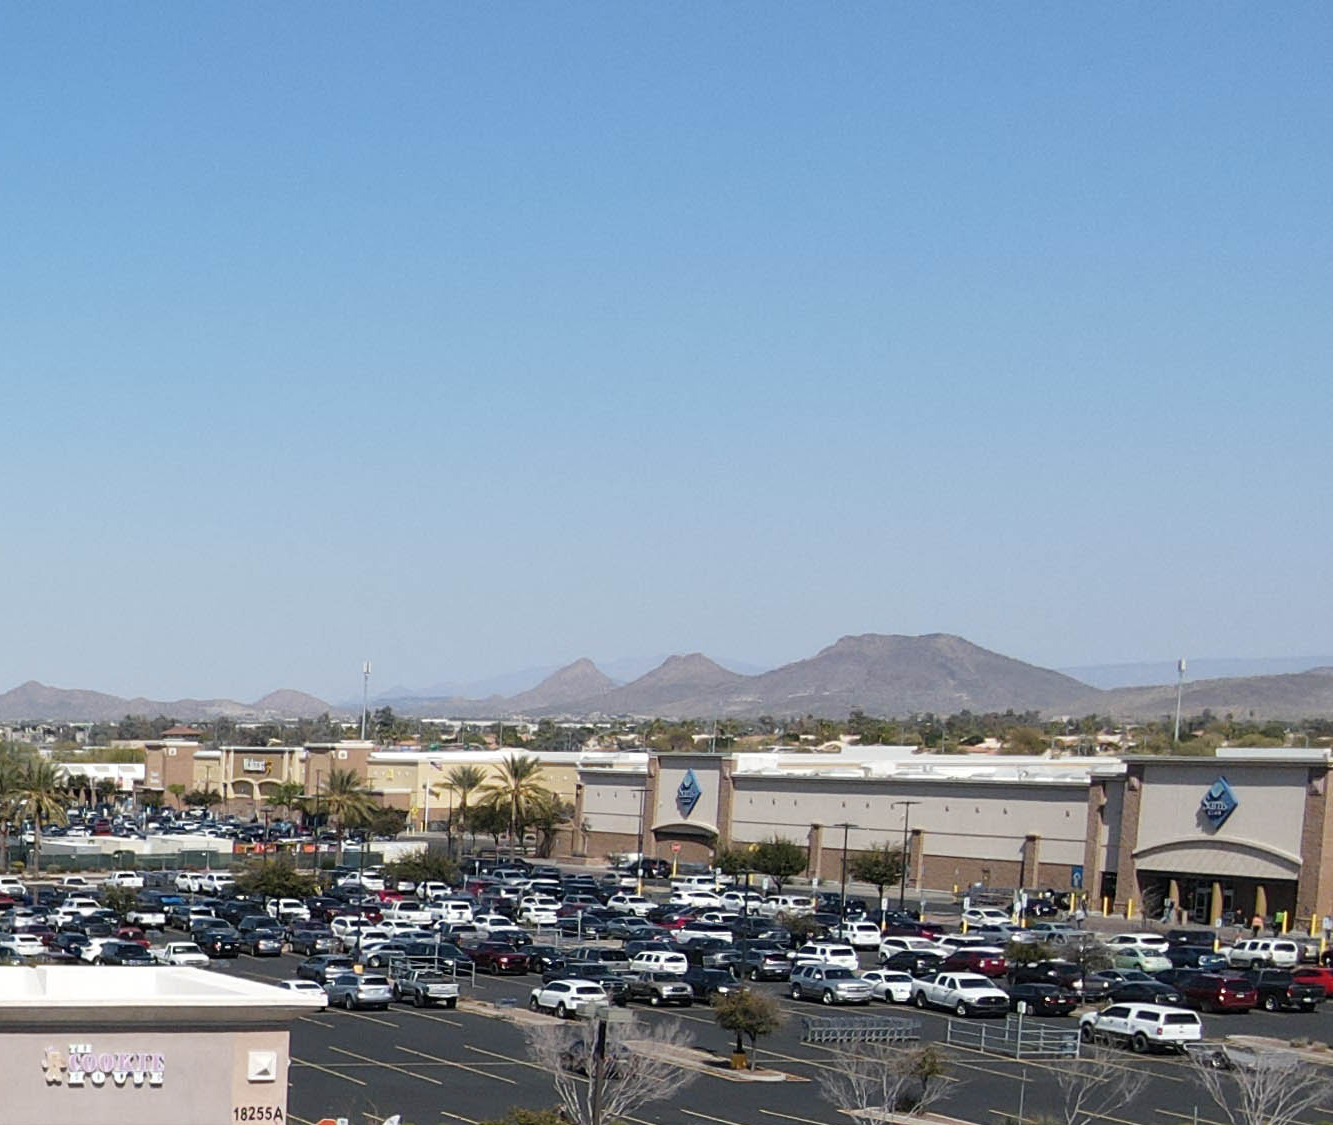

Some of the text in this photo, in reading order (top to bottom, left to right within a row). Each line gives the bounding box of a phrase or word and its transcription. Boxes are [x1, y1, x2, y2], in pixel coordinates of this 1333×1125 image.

[68, 1044, 93, 1053] THE
[68, 1053, 165, 1072] COOKIE
[68, 1071, 163, 1085] HOUSE
[233, 1106, 284, 1120] 18255A
